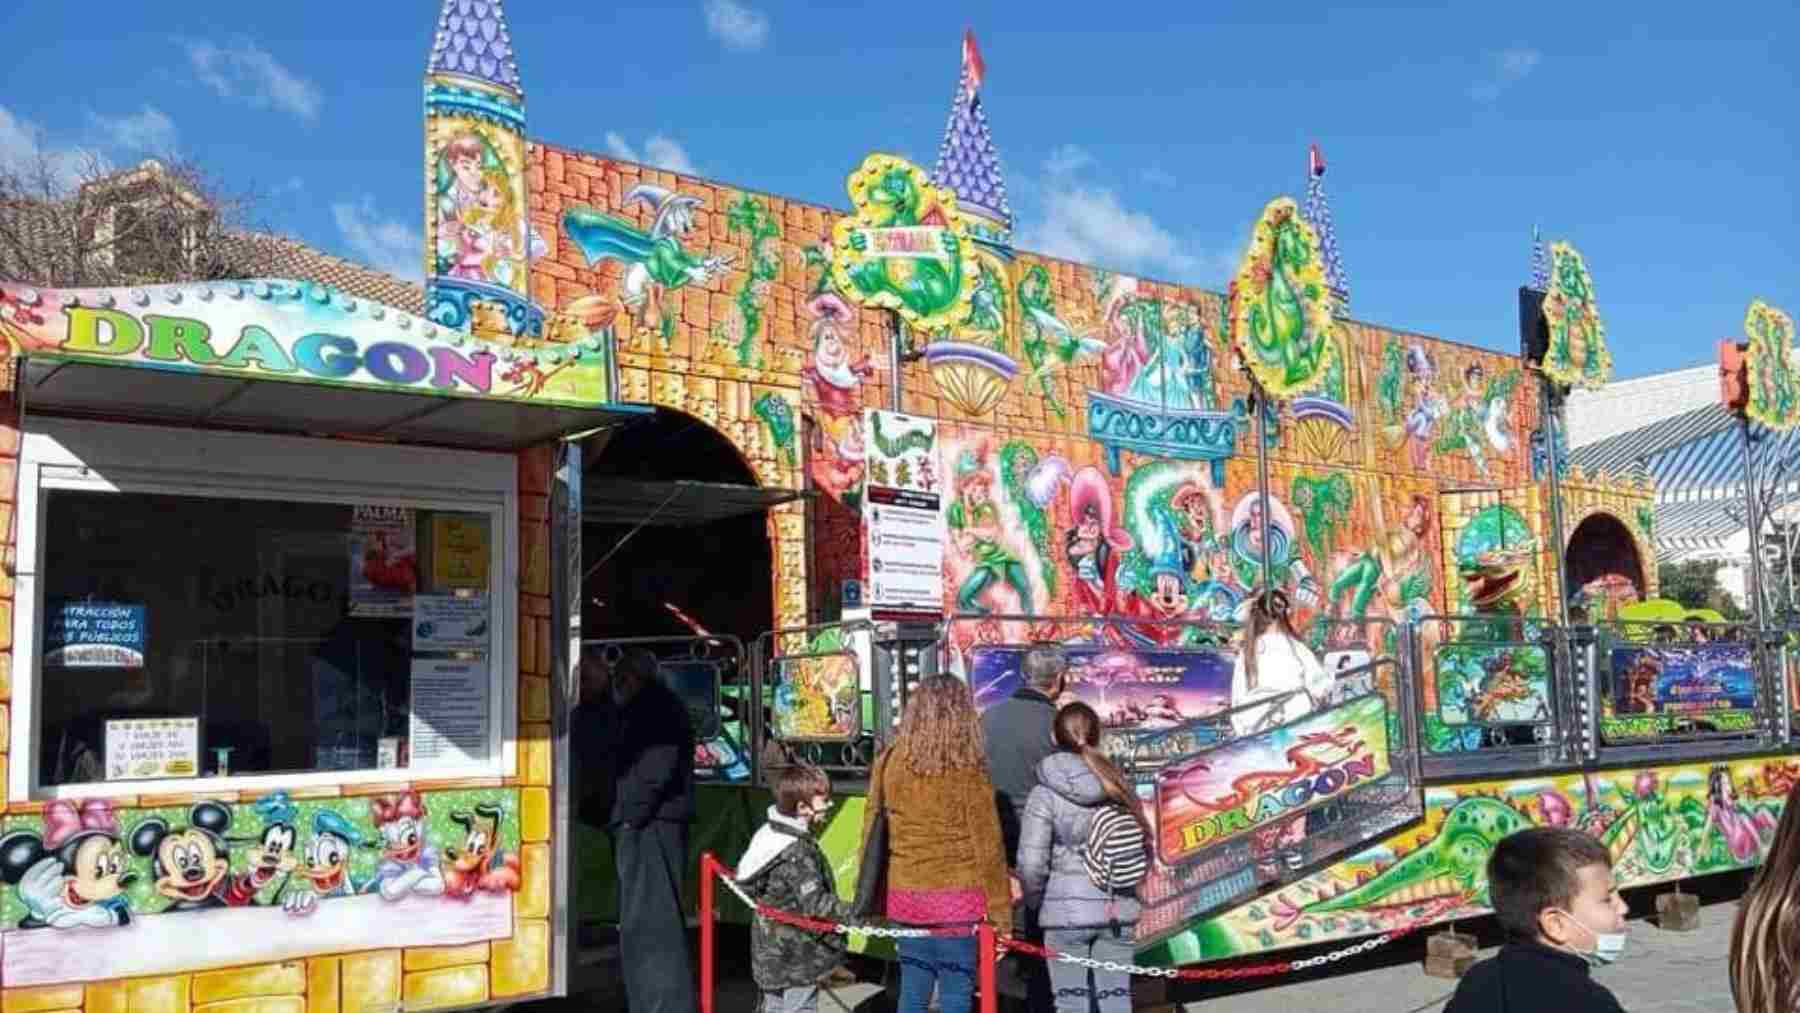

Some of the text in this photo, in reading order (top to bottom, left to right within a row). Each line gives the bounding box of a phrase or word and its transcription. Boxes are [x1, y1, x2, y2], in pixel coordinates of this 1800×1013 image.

[62, 304, 496, 394] DRAGON
[212, 573, 349, 615] DRAGO
[1181, 753, 1375, 849] DRAGON
